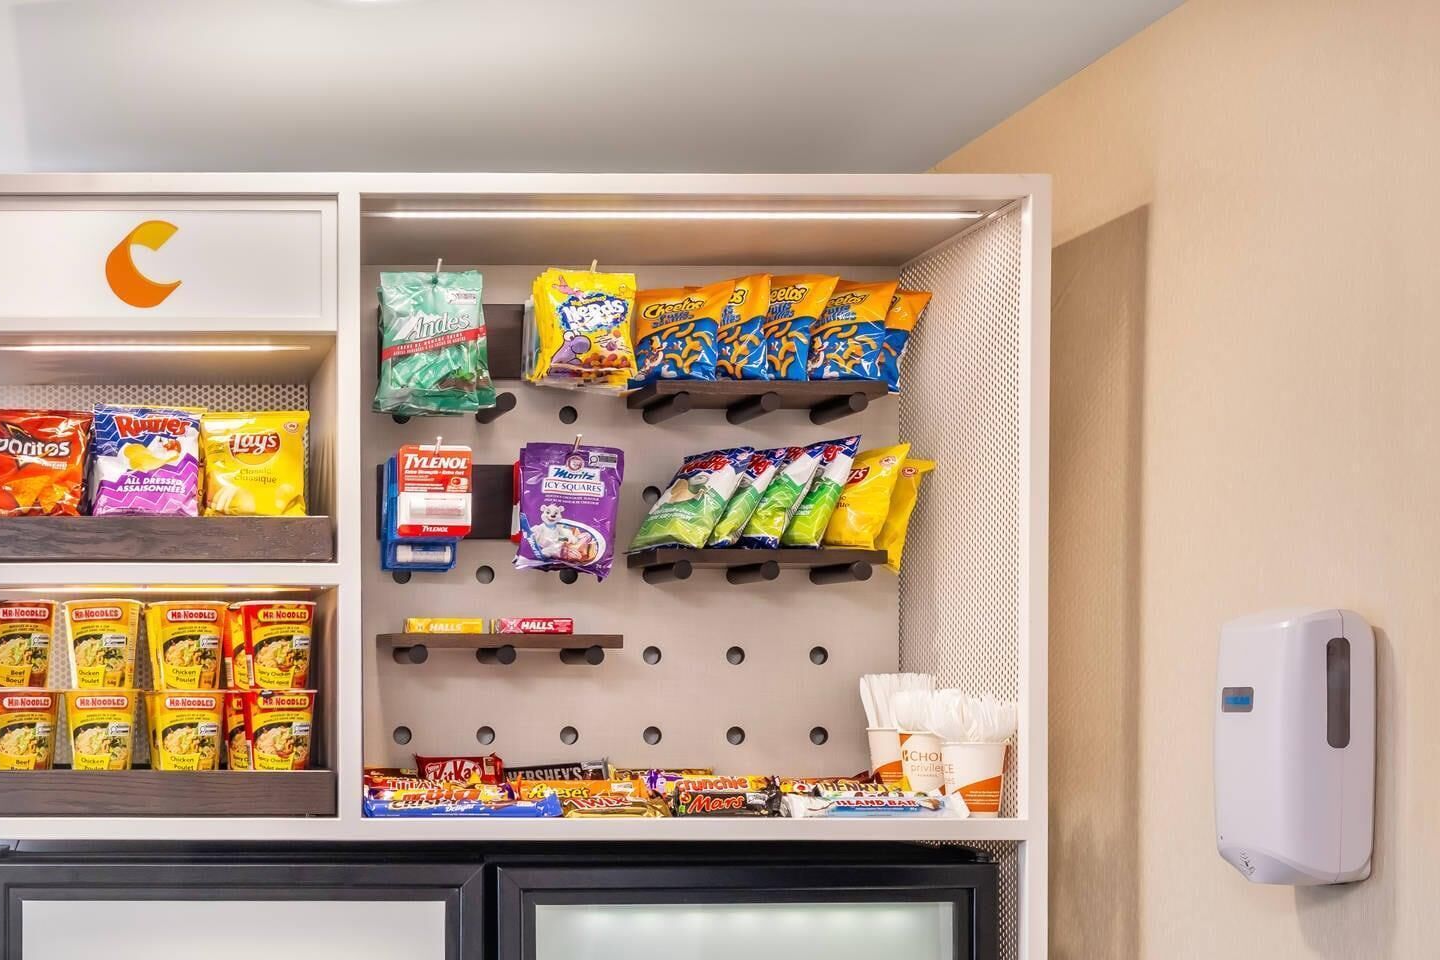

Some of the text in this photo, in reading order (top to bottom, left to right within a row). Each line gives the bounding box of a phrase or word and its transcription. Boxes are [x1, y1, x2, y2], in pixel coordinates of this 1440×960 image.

[769, 286, 808, 305] eetos
[643, 297, 705, 320] Cheetos
[407, 311, 472, 342] Andes
[233, 432, 278, 455] Lay's
[404, 453, 468, 469] TYLENOL
[553, 467, 595, 480] Moritz
[125, 477, 183, 486] ALL DRESSED
[544, 481, 602, 493] ICY SQUARES
[16, 608, 47, 618] NOODLES
[84, 609, 119, 618] NOODLES
[184, 610, 215, 620] NOODLES
[276, 610, 307, 619] NOODLES
[429, 623, 463, 632] HALLS
[521, 622, 553, 631] HALLS
[172, 668, 196, 676] Chicken
[175, 676, 196, 684] Poulet
[20, 697, 50, 707] NOODLES
[91, 697, 125, 707] NOODLES
[181, 698, 213, 707] NOODLES
[275, 696, 307, 706] NOODLES
[81, 757, 104, 765] Chicken
[170, 756, 195, 764] Chicken
[910, 751, 943, 762] CHOI
[687, 794, 745, 813] Mars
